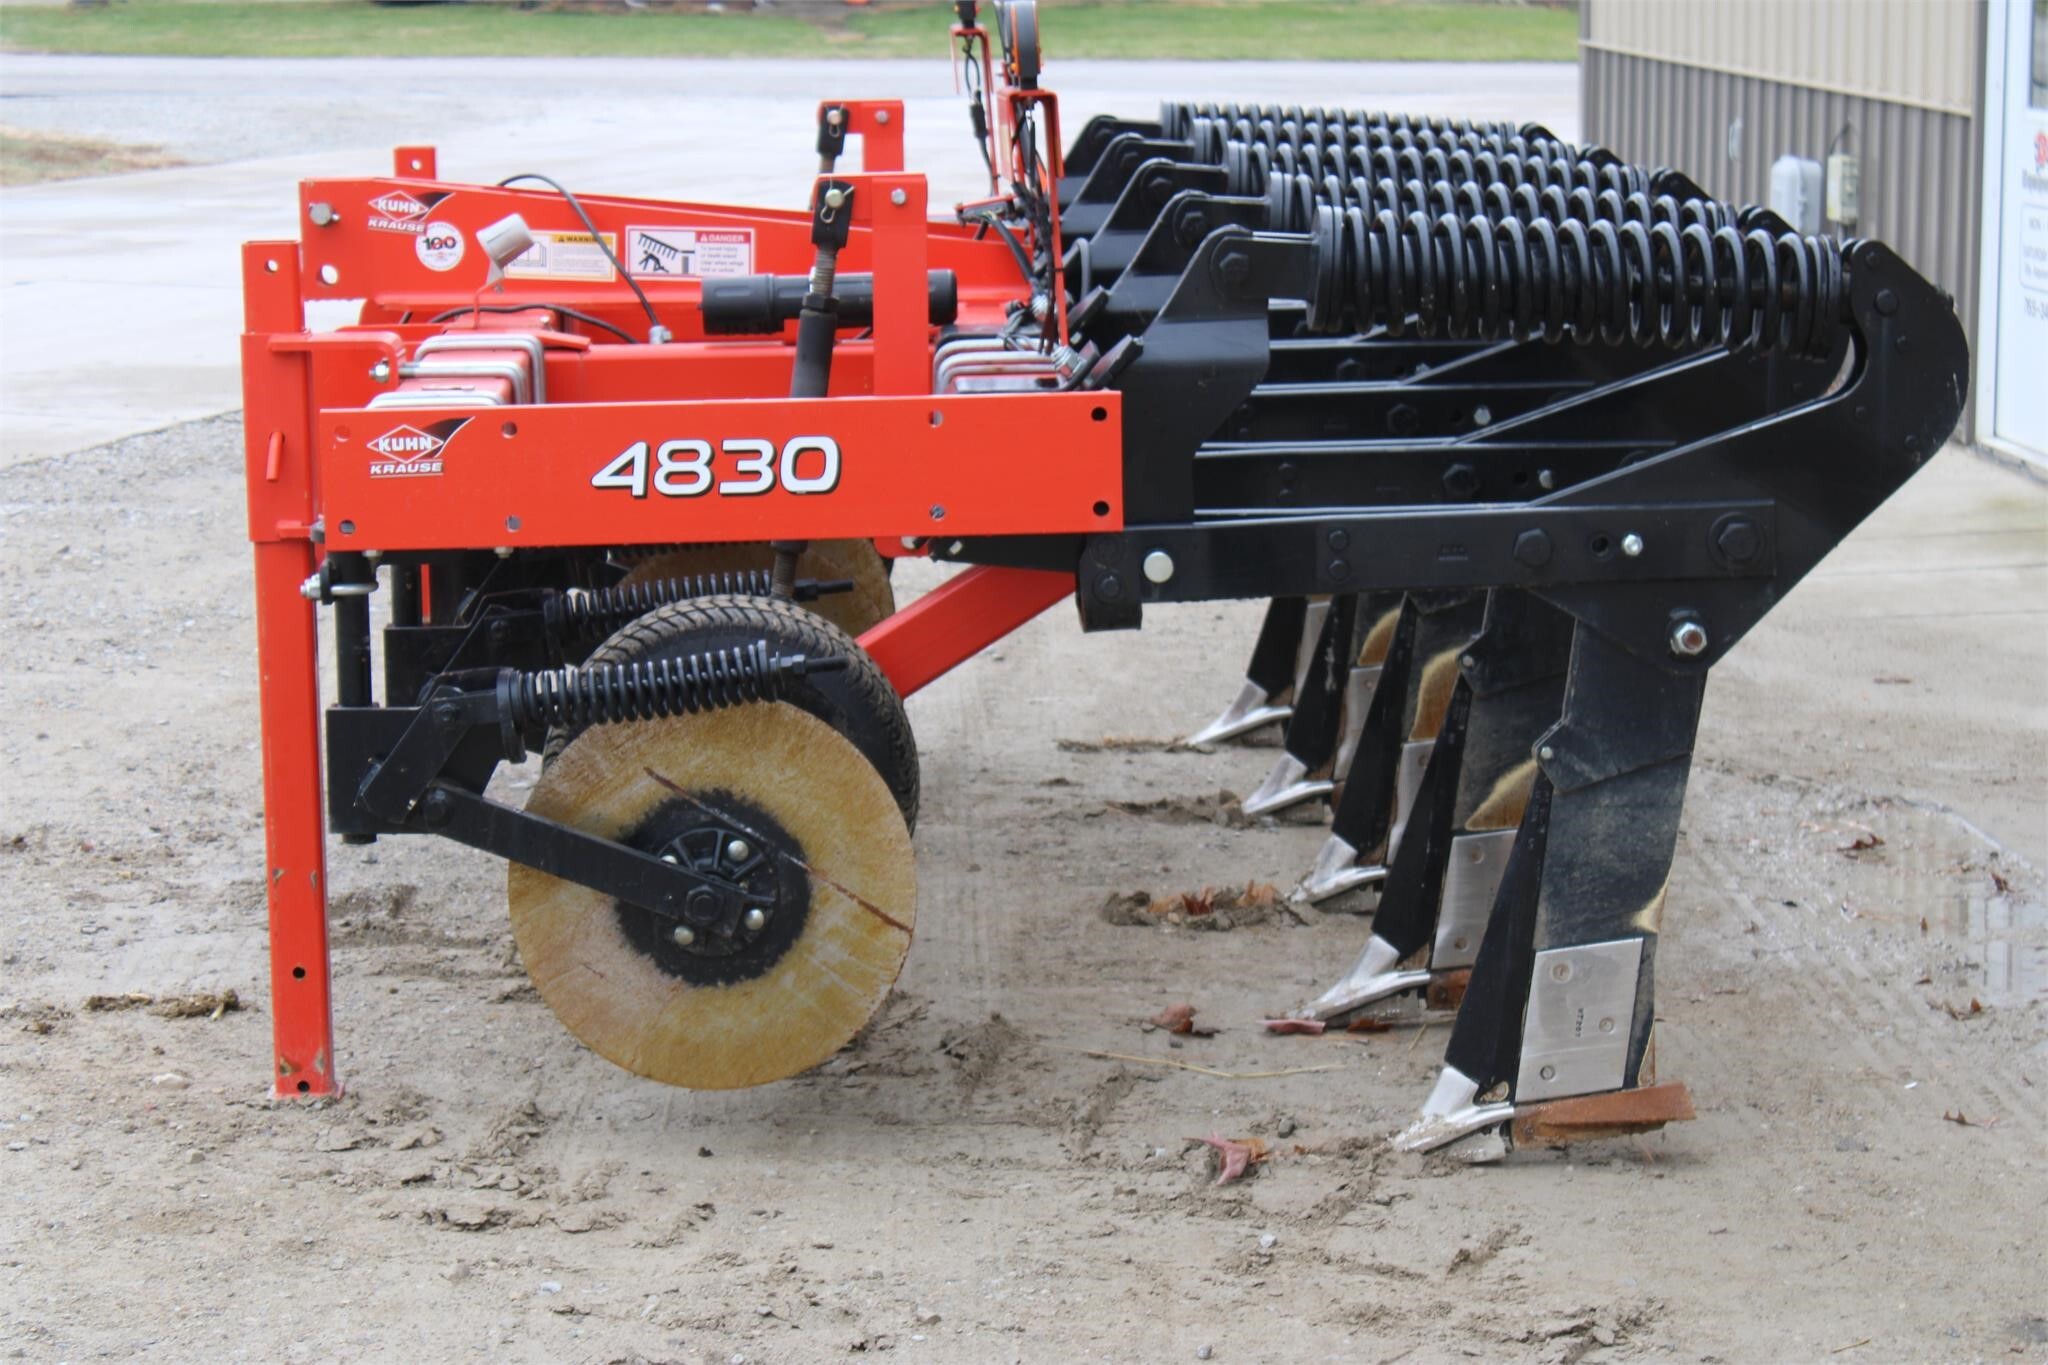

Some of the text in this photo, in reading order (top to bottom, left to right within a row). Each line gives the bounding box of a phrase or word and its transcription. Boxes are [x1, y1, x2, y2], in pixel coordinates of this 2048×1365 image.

[377, 199, 420, 214] KUHN
[368, 217, 425, 233] KRAUSE
[422, 236, 457, 250] 100
[709, 233, 744, 242] DANGER
[378, 437, 432, 452] KUHN
[370, 462, 443, 475] KRAUSE
[591, 436, 841, 499] 4830
